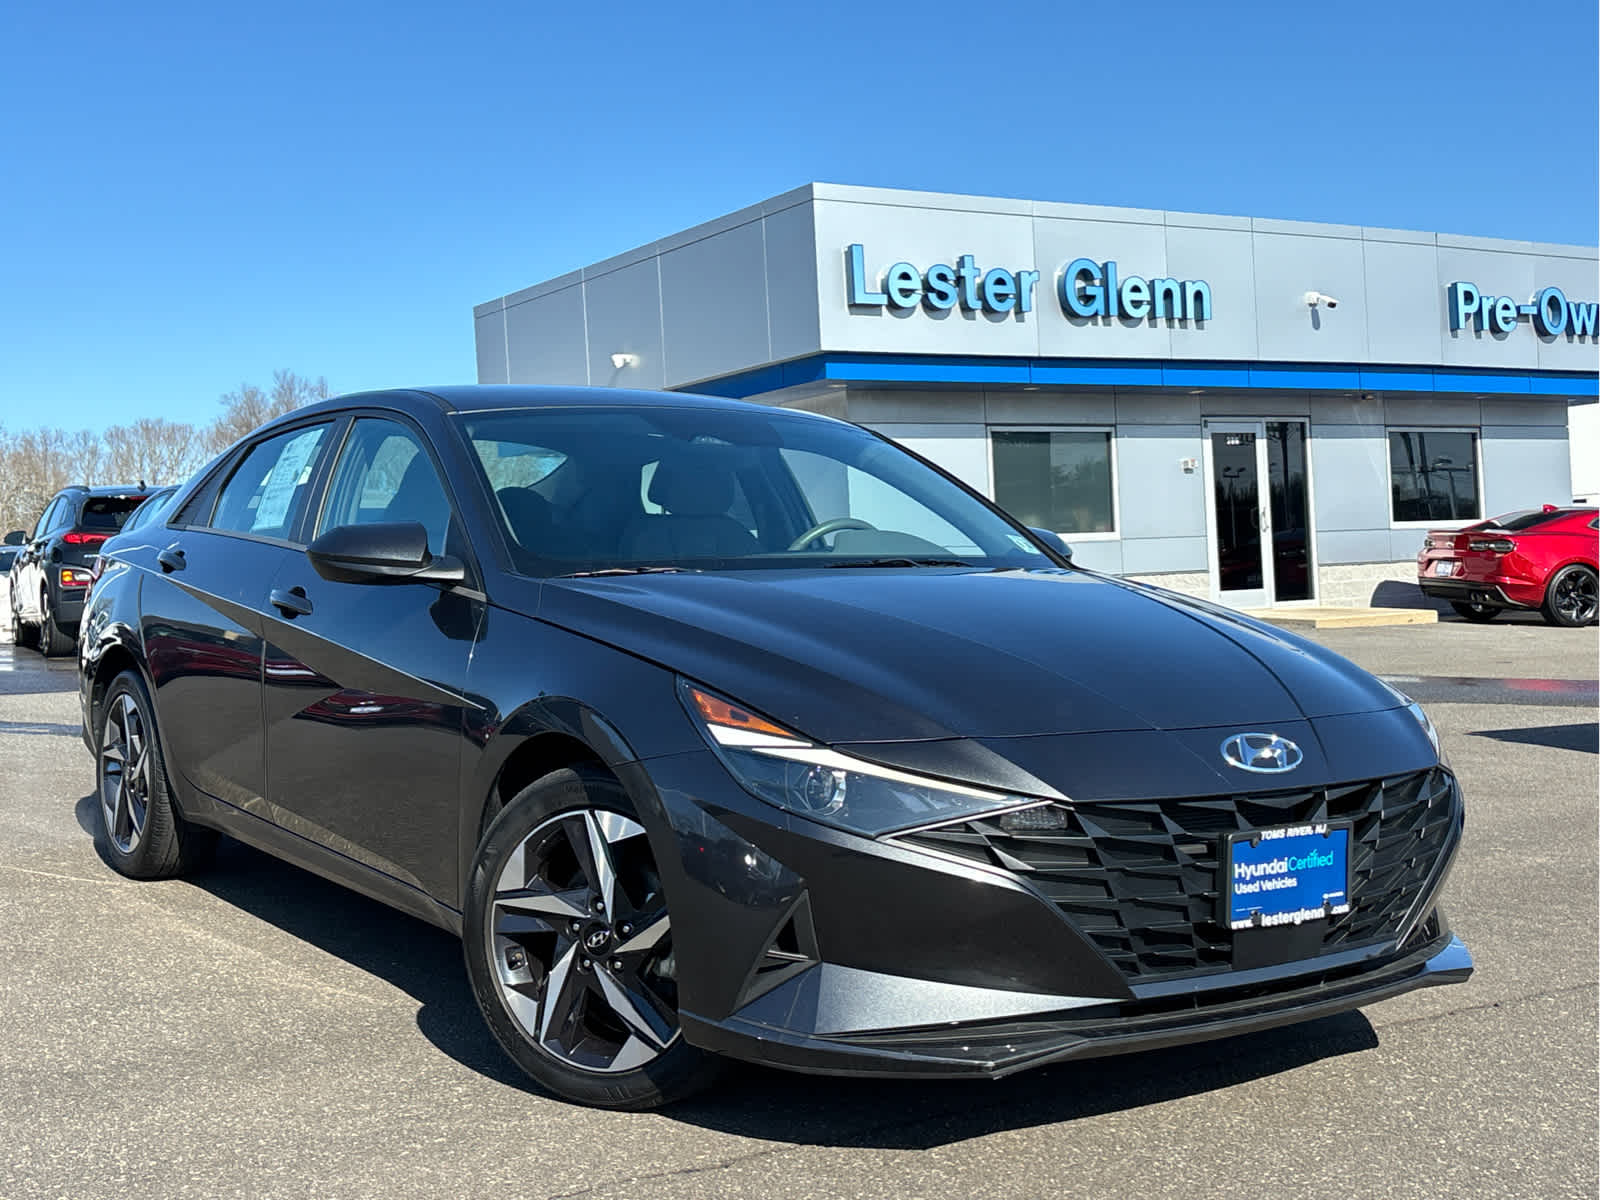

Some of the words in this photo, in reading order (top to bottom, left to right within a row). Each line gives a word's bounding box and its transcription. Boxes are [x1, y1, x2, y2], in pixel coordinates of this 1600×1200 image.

[846, 243, 1040, 314] Lester
[1058, 257, 1213, 321] Glenn
[1447, 281, 1599, 337] Pre-Ow
[1261, 828, 1286, 841] TOMS
[1315, 823, 1328, 835] NJ
[1234, 880, 1260, 895] Used
[1261, 876, 1298, 891] Vehicles
[1261, 908, 1325, 927] lesterglenn
